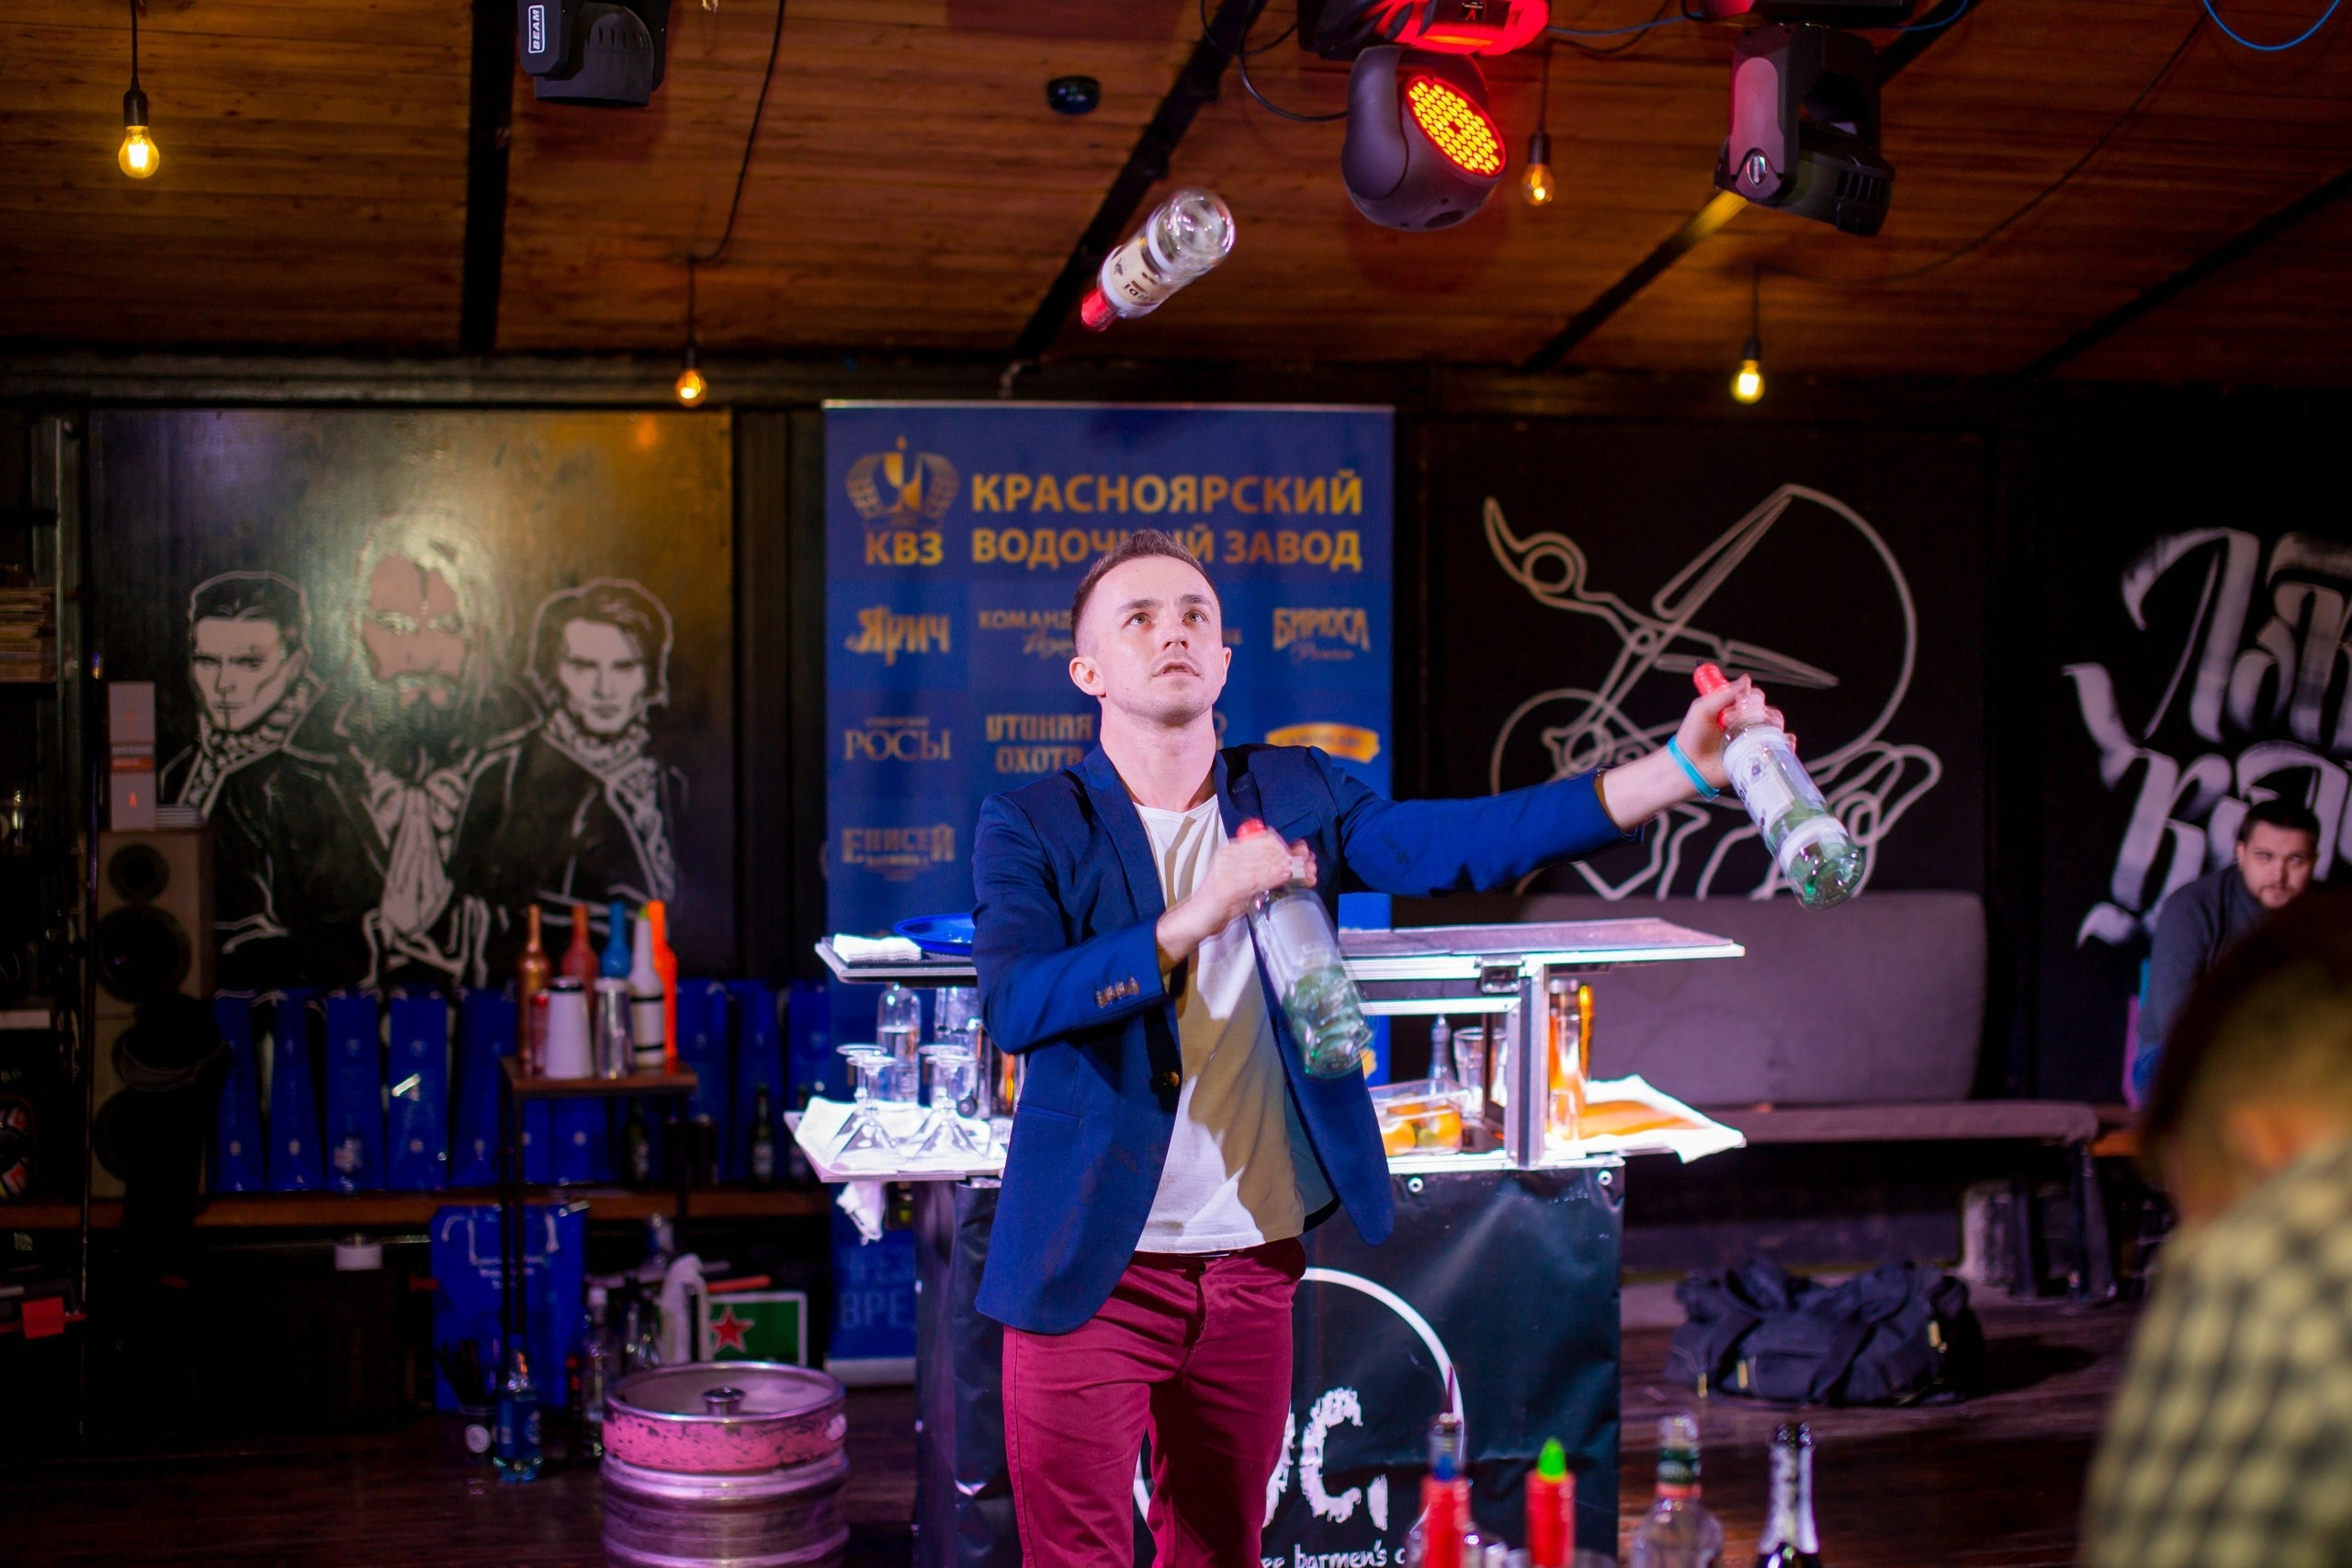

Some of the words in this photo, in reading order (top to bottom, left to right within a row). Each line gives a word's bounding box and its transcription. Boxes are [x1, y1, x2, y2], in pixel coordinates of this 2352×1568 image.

[532, 8, 541, 51] BEAM
[970, 468, 1363, 515] КРАСНОЯРСКИЙ
[864, 529, 944, 567] КВЗ
[970, 523, 1216, 571] ВОДОЧЙ
[1222, 528, 1363, 573] ЗАВОД
[843, 728, 953, 762] РОСЫ
